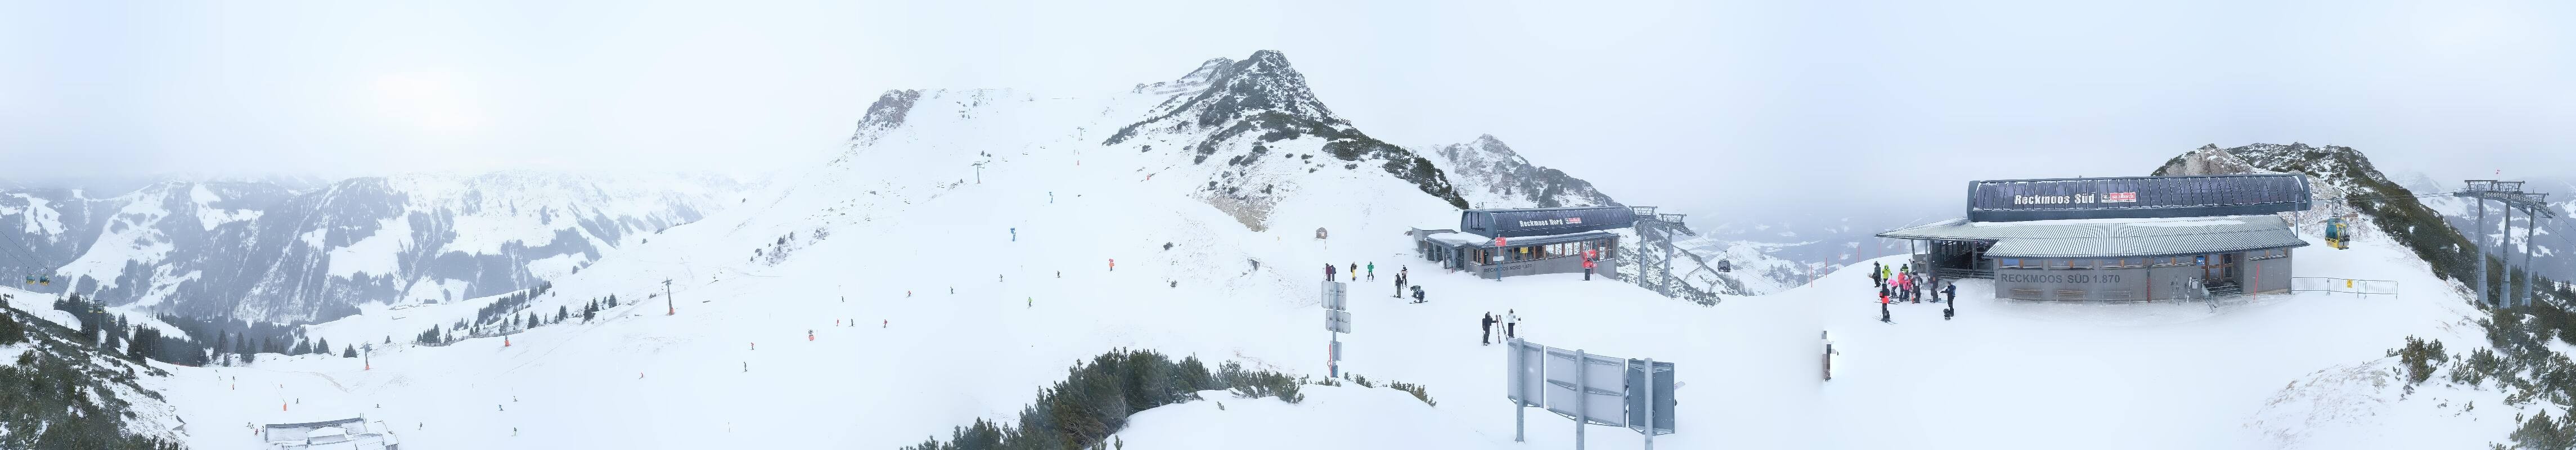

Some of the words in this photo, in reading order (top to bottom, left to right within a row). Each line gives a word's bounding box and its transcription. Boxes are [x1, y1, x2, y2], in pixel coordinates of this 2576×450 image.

[2015, 195, 2070, 204] Reckmoos
[2075, 193, 2094, 204] Süd
[2001, 273, 2062, 283] RECKMOOS
[2067, 273, 2089, 283] SÜD
[2093, 274, 2120, 283] 1.870
